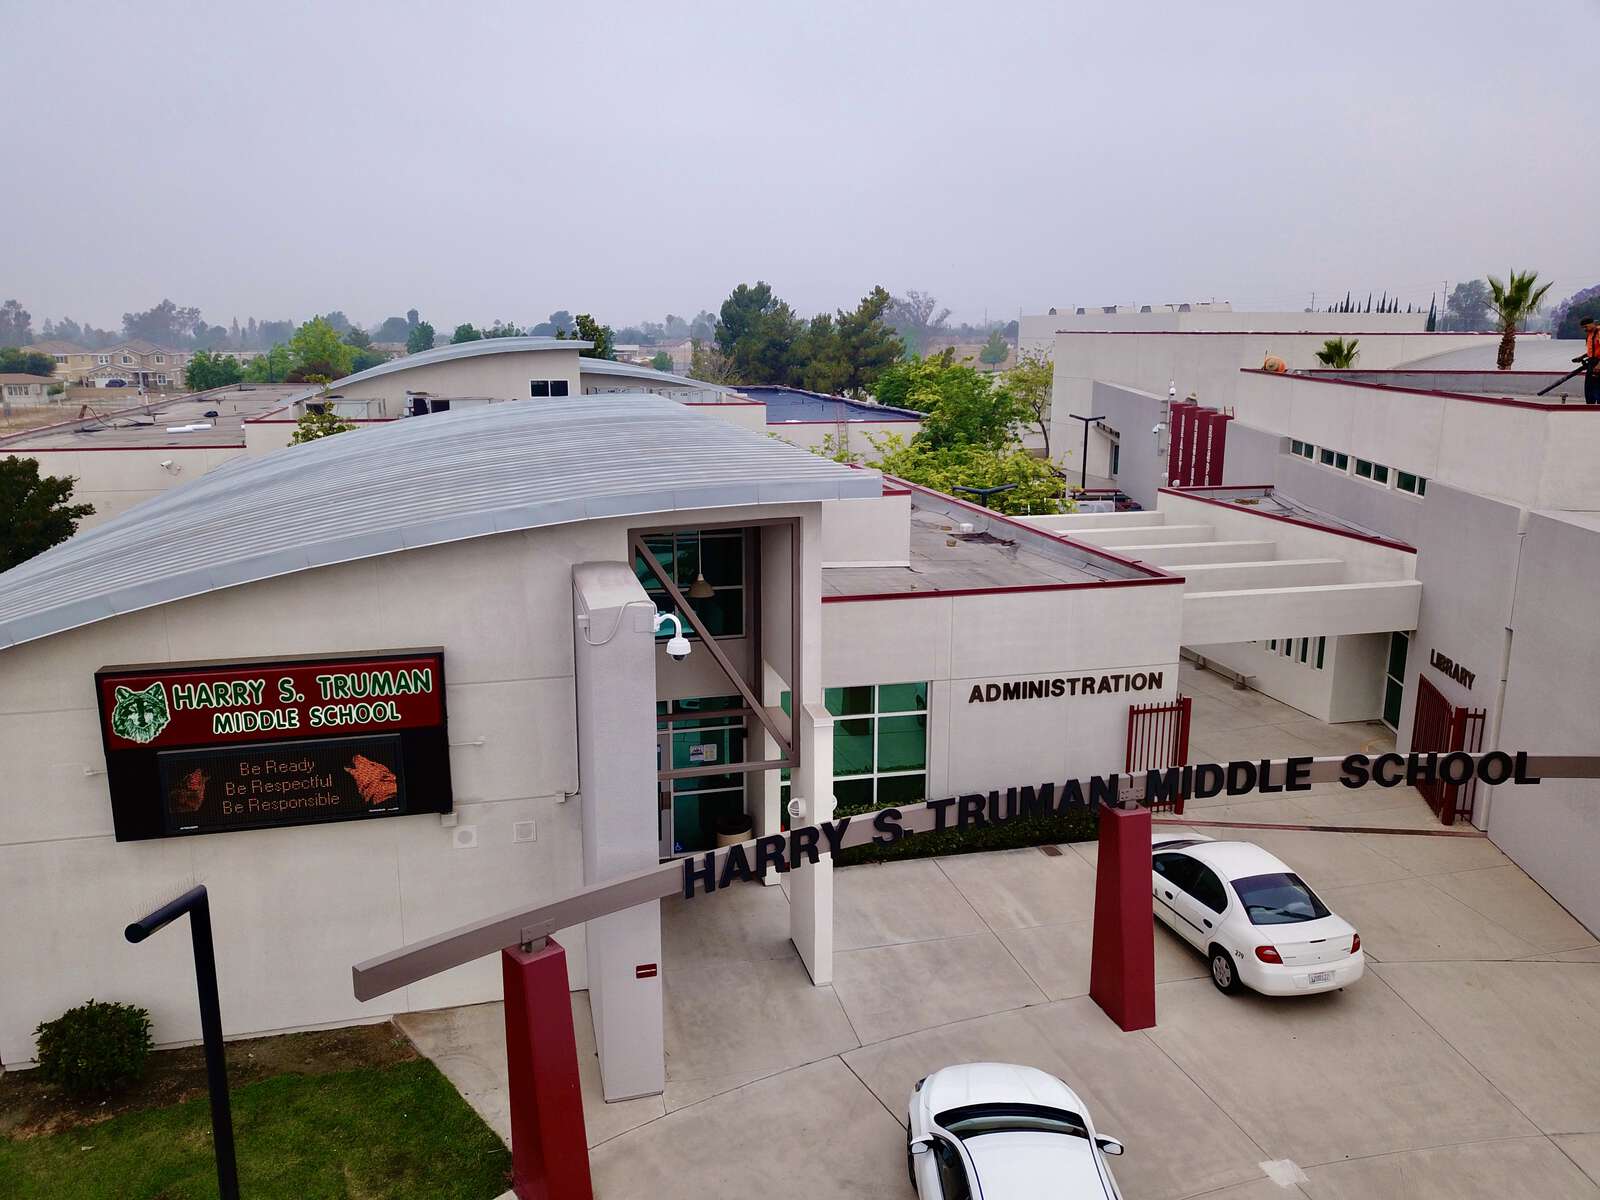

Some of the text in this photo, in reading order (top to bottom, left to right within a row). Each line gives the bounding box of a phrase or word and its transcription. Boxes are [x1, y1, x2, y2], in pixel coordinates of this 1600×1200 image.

[1430, 648, 1476, 690] LIBRARY
[173, 668, 432, 710] HARRY S. TRUMAN
[968, 671, 1164, 704] ADMINISTRATION
[212, 701, 401, 735] MIDDLE SCHOOL
[240, 757, 315, 776] Be Ready
[225, 773, 333, 796] Be Respectful
[222, 792, 340, 815] Be Responsible
[683, 751, 1541, 899] HARRY S. TRUMAN MIDDLE SCHOOL
